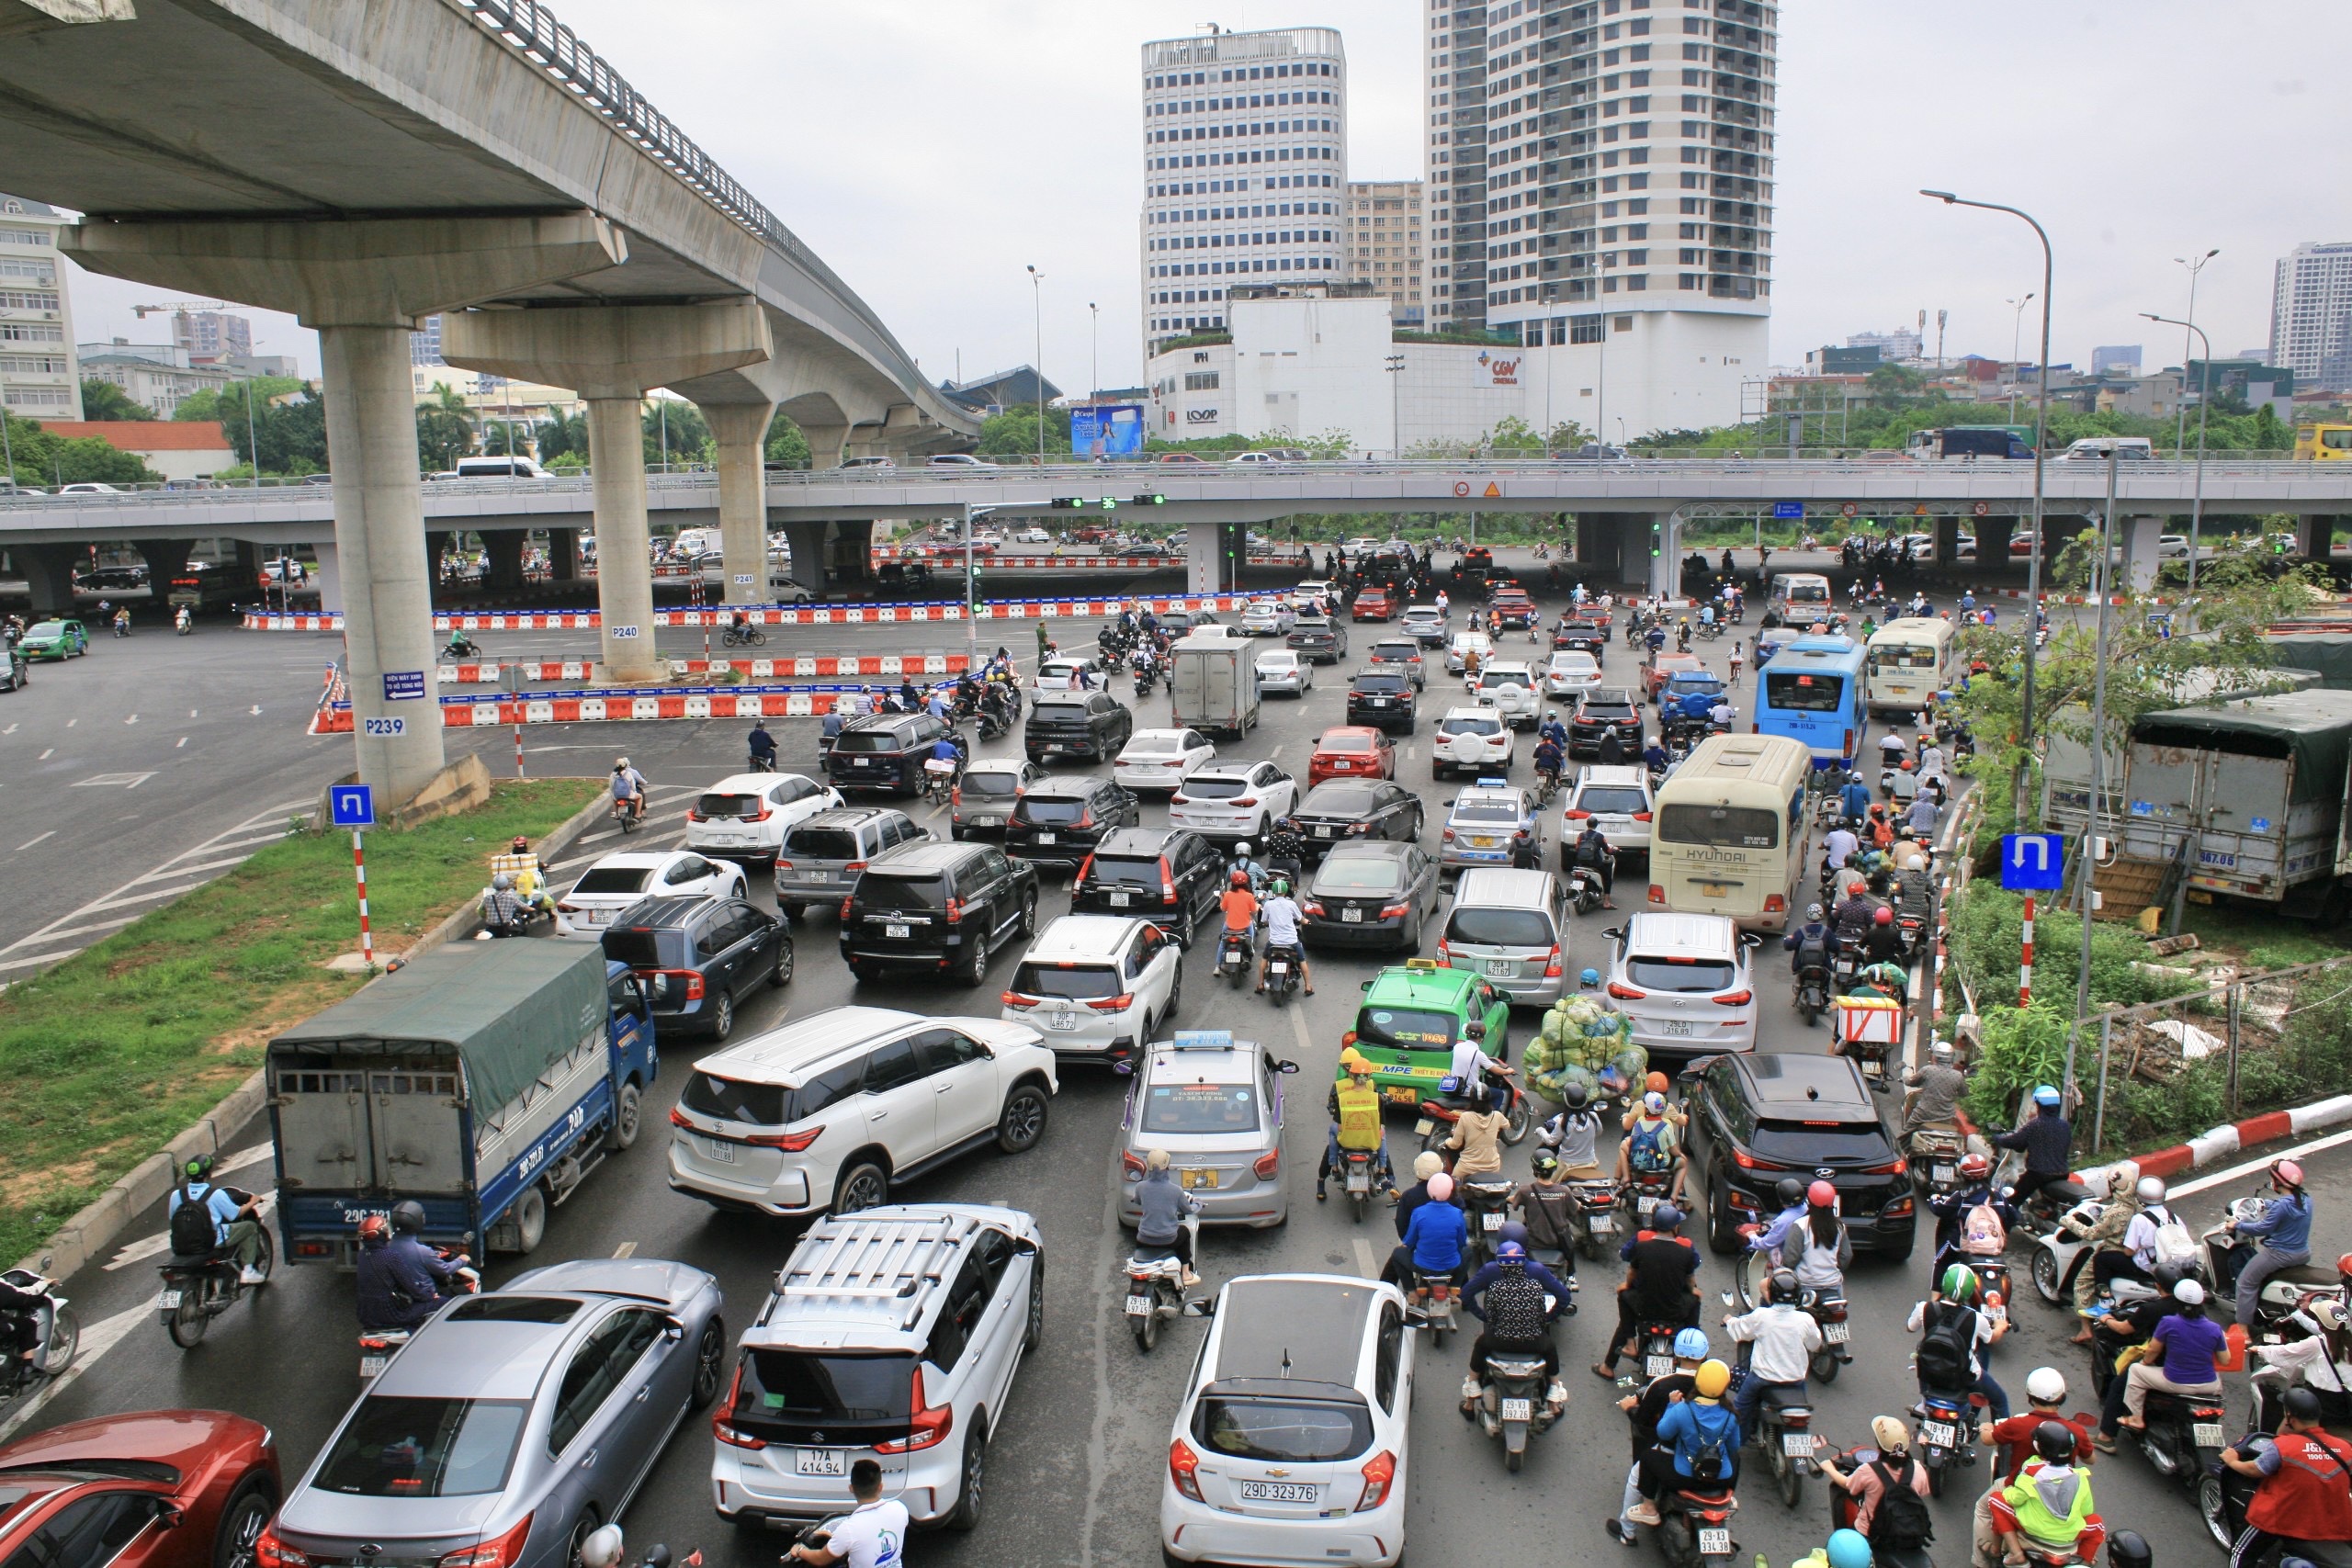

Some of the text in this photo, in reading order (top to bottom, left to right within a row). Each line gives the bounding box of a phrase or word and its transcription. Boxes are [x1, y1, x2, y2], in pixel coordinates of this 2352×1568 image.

[1492, 360, 1517, 376] CGV
[1187, 410, 1217, 421] LOOP
[613, 628, 637, 637] P240
[367, 720, 404, 733] P239
[1687, 851, 1746, 862] HYUNDAI
[1052, 1021, 1074, 1029] 486.72
[1421, 1033, 1447, 1043] 1055
[1383, 1066, 1413, 1075] MPE
[1506, 1400, 1526, 1409] 29-V3
[1504, 1410, 1528, 1418] 392.26
[2198, 1425, 2219, 1435] 29-F1
[811, 1450, 831, 1461] 17A
[1786, 1446, 1812, 1455] 003.37
[801, 1462, 840, 1473] 414.94
[1244, 1483, 1314, 1500] 29D-329.76
[1703, 1530, 1725, 1540] 29-X3
[1702, 1541, 1728, 1552] 334.38
